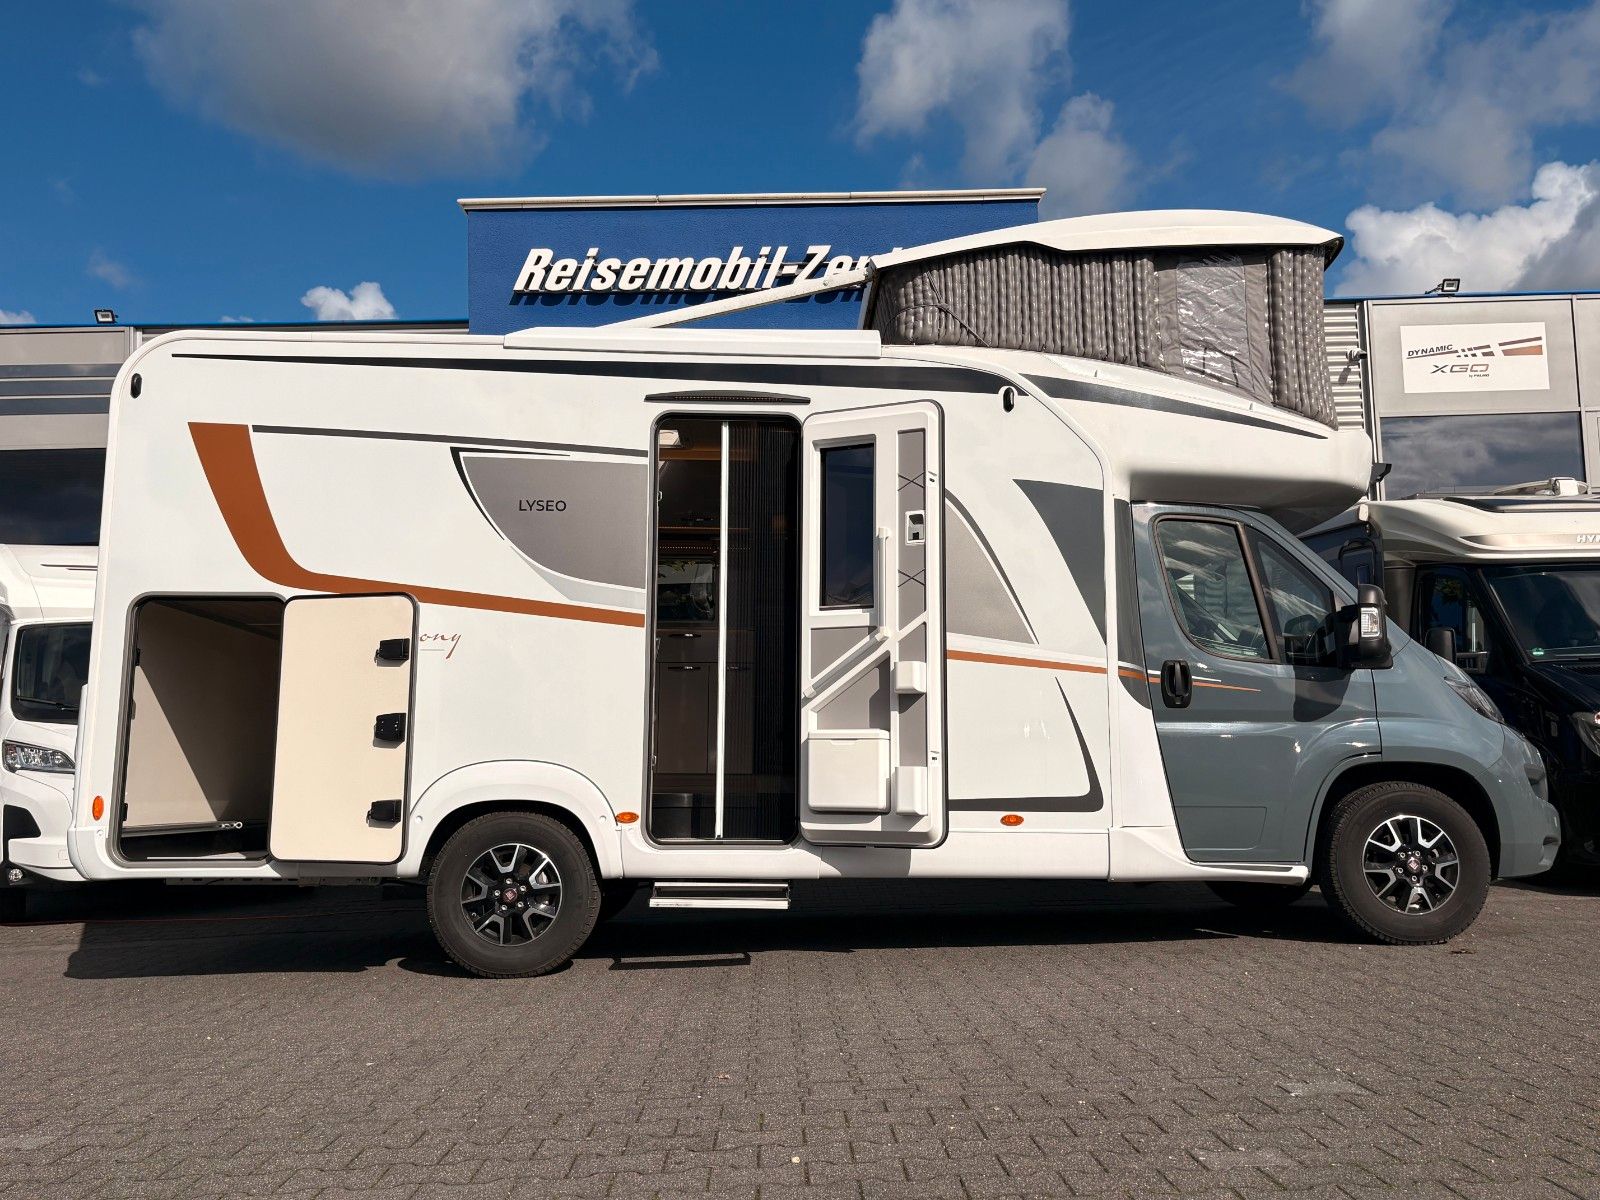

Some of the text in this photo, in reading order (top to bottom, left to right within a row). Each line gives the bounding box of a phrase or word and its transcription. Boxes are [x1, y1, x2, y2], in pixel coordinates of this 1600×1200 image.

[1407, 344, 1454, 357] DYNAMIC
[1431, 364, 1489, 374] XGO
[518, 499, 567, 512] LYSEO
[418, 632, 462, 660] ony
